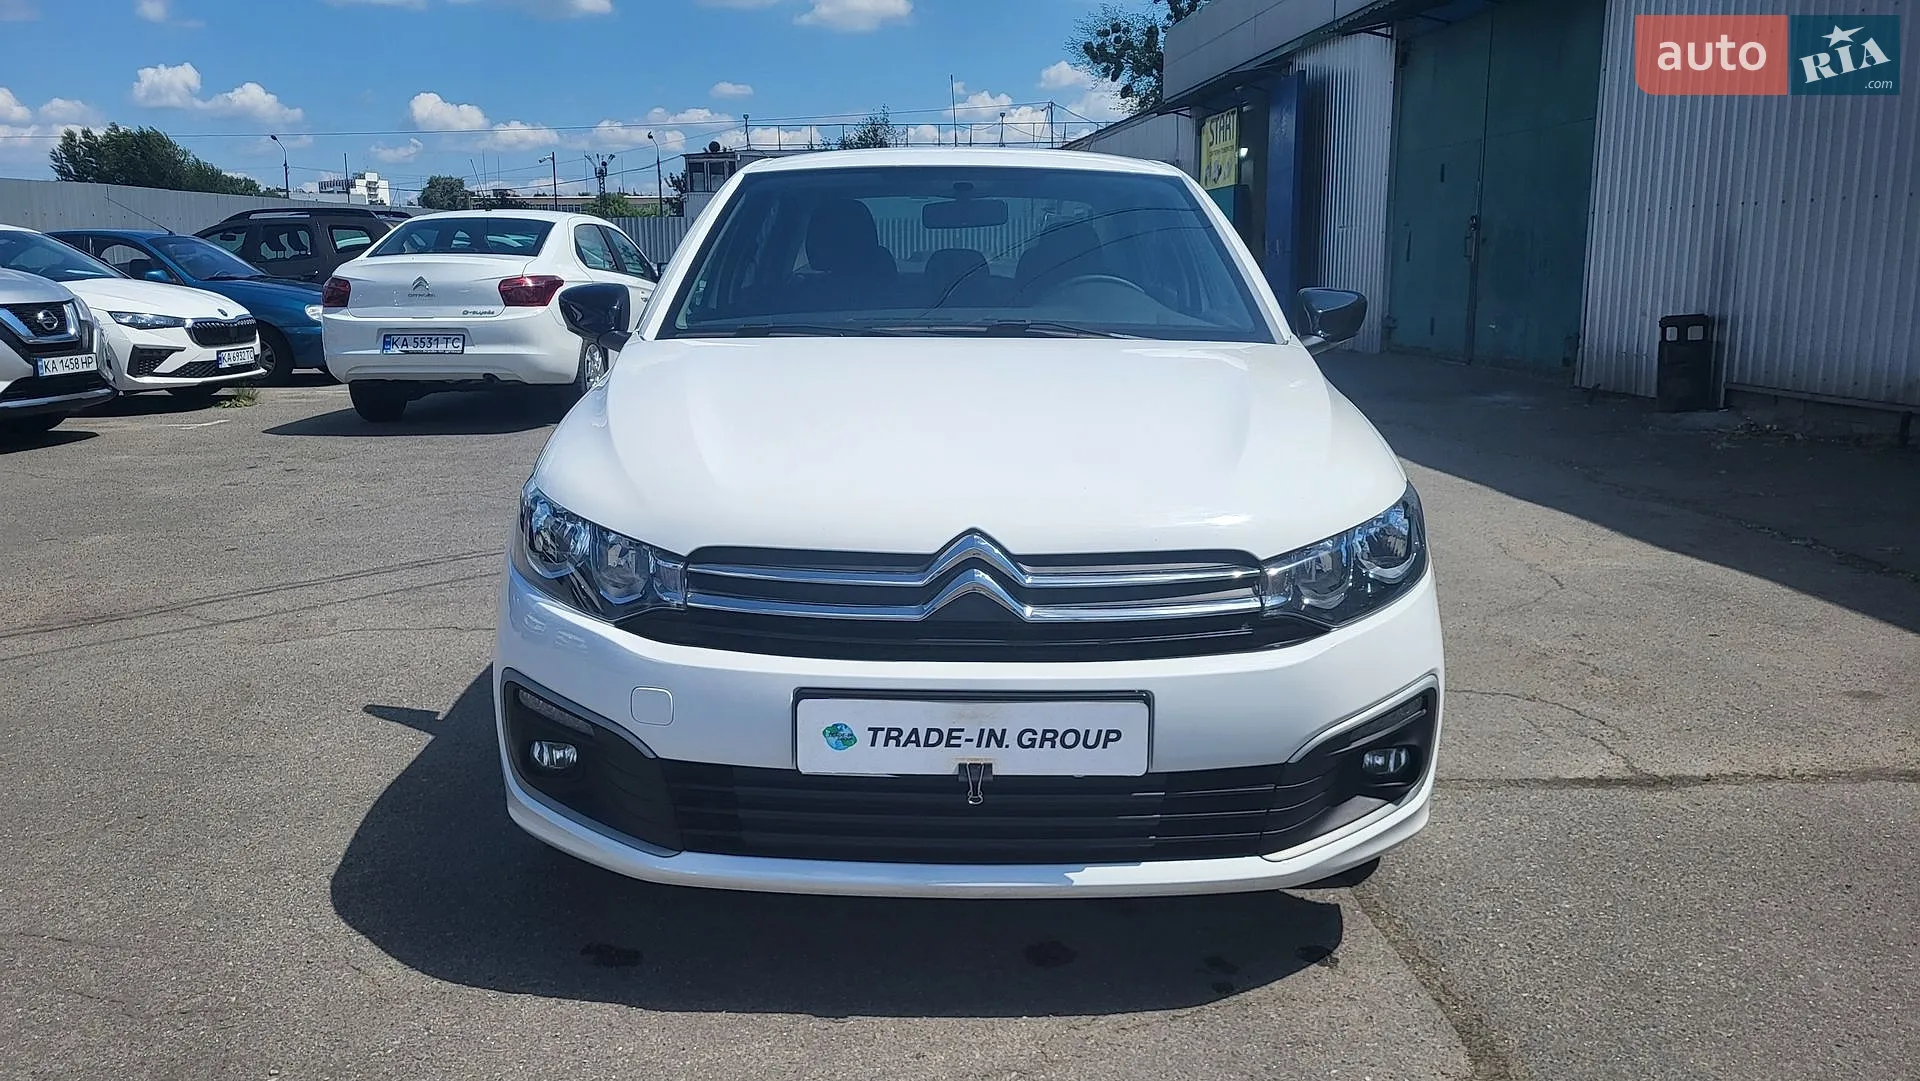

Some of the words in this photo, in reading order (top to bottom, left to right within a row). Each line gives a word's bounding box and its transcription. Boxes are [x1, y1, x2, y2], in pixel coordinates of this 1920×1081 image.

[390, 336, 409, 349] KA
[412, 336, 440, 349] 5531
[442, 336, 461, 349] TC
[43, 359, 59, 373] KA
[59, 356, 80, 371] 1458
[80, 355, 94, 369] HP
[1017, 728, 1122, 750] GROUP
